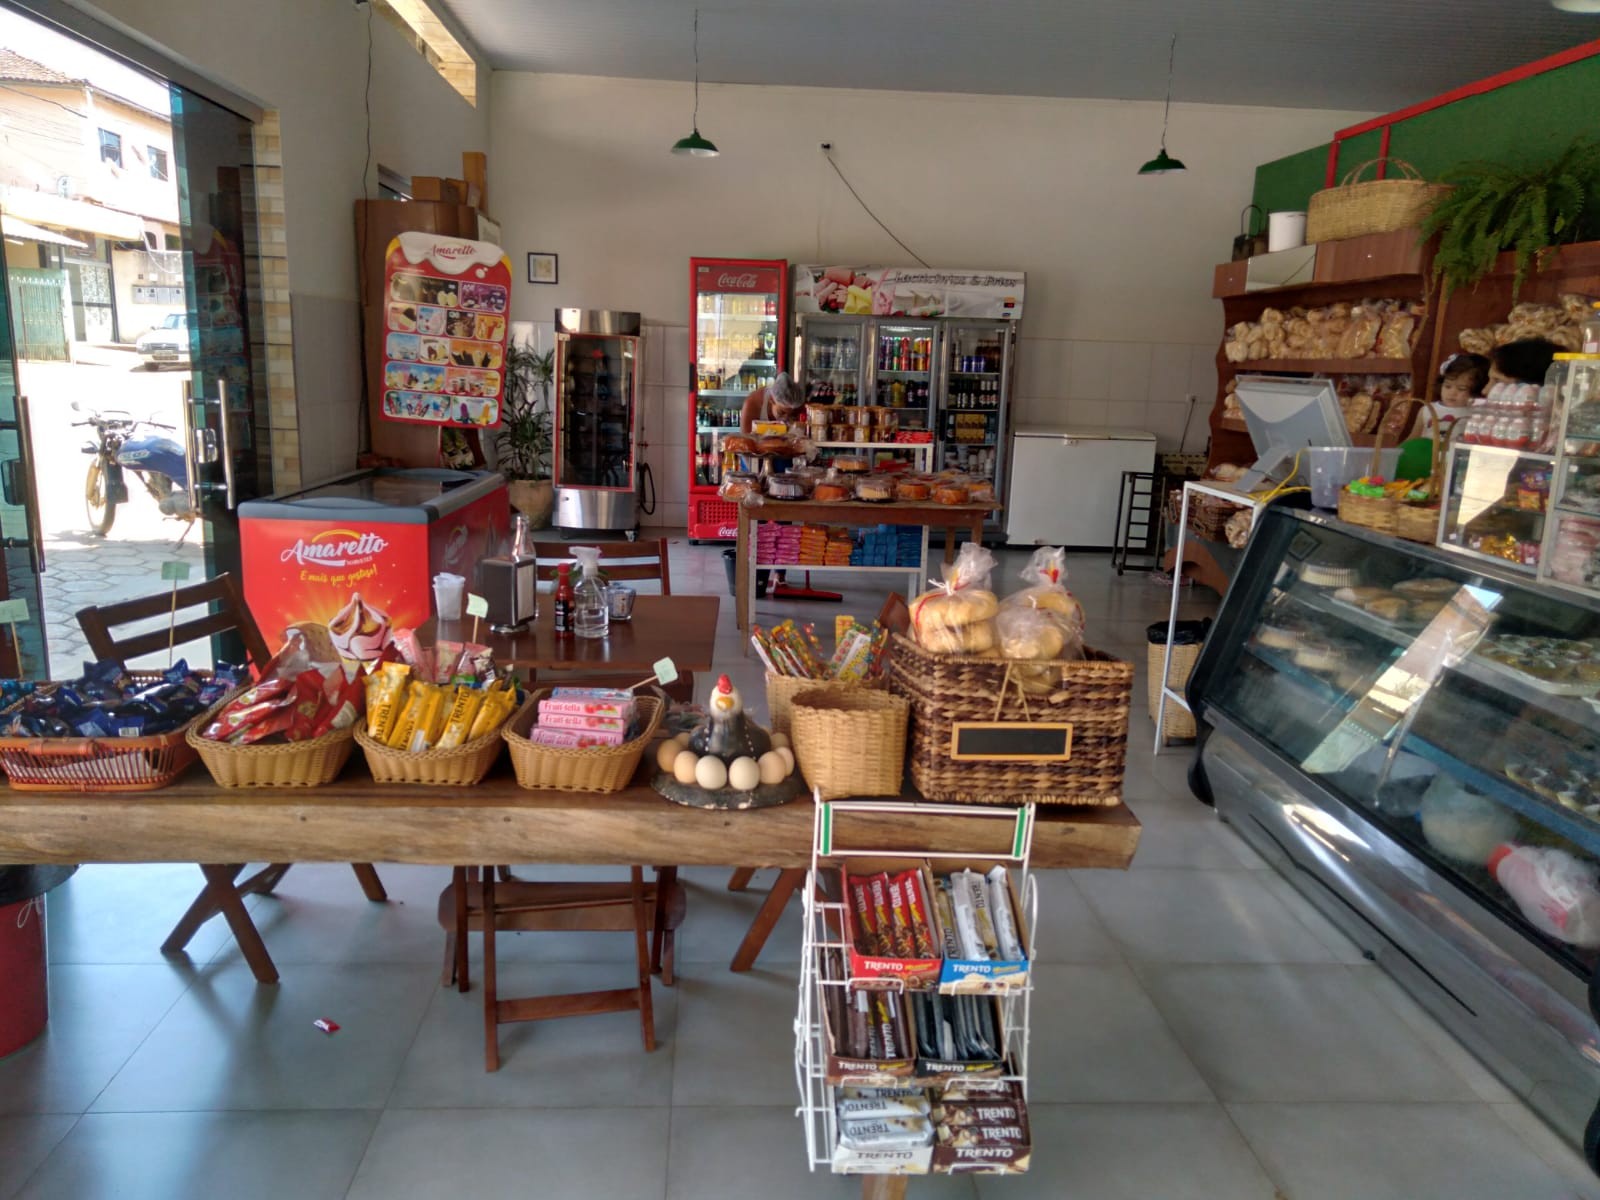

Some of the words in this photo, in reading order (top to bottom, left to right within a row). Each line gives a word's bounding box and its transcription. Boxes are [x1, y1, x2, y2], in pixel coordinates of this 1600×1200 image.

[718, 272, 758, 289] Coca-Cola
[280, 532, 389, 566] Amaretto
[451, 691, 471, 723] TRENTO
[376, 704, 392, 742] TRENTO
[864, 960, 903, 972] TRENTO
[953, 963, 991, 974] TRENTO
[838, 1061, 877, 1071] TRENTO
[925, 1062, 965, 1073] TRENTO
[845, 1101, 888, 1113] TRENTO
[976, 1107, 1016, 1121] TRENTO
[849, 1122, 890, 1136] TRENTO
[981, 1127, 1022, 1140] TRENTO
[856, 1151, 913, 1159] TRENTO
[956, 1147, 1013, 1159] TRENTO
